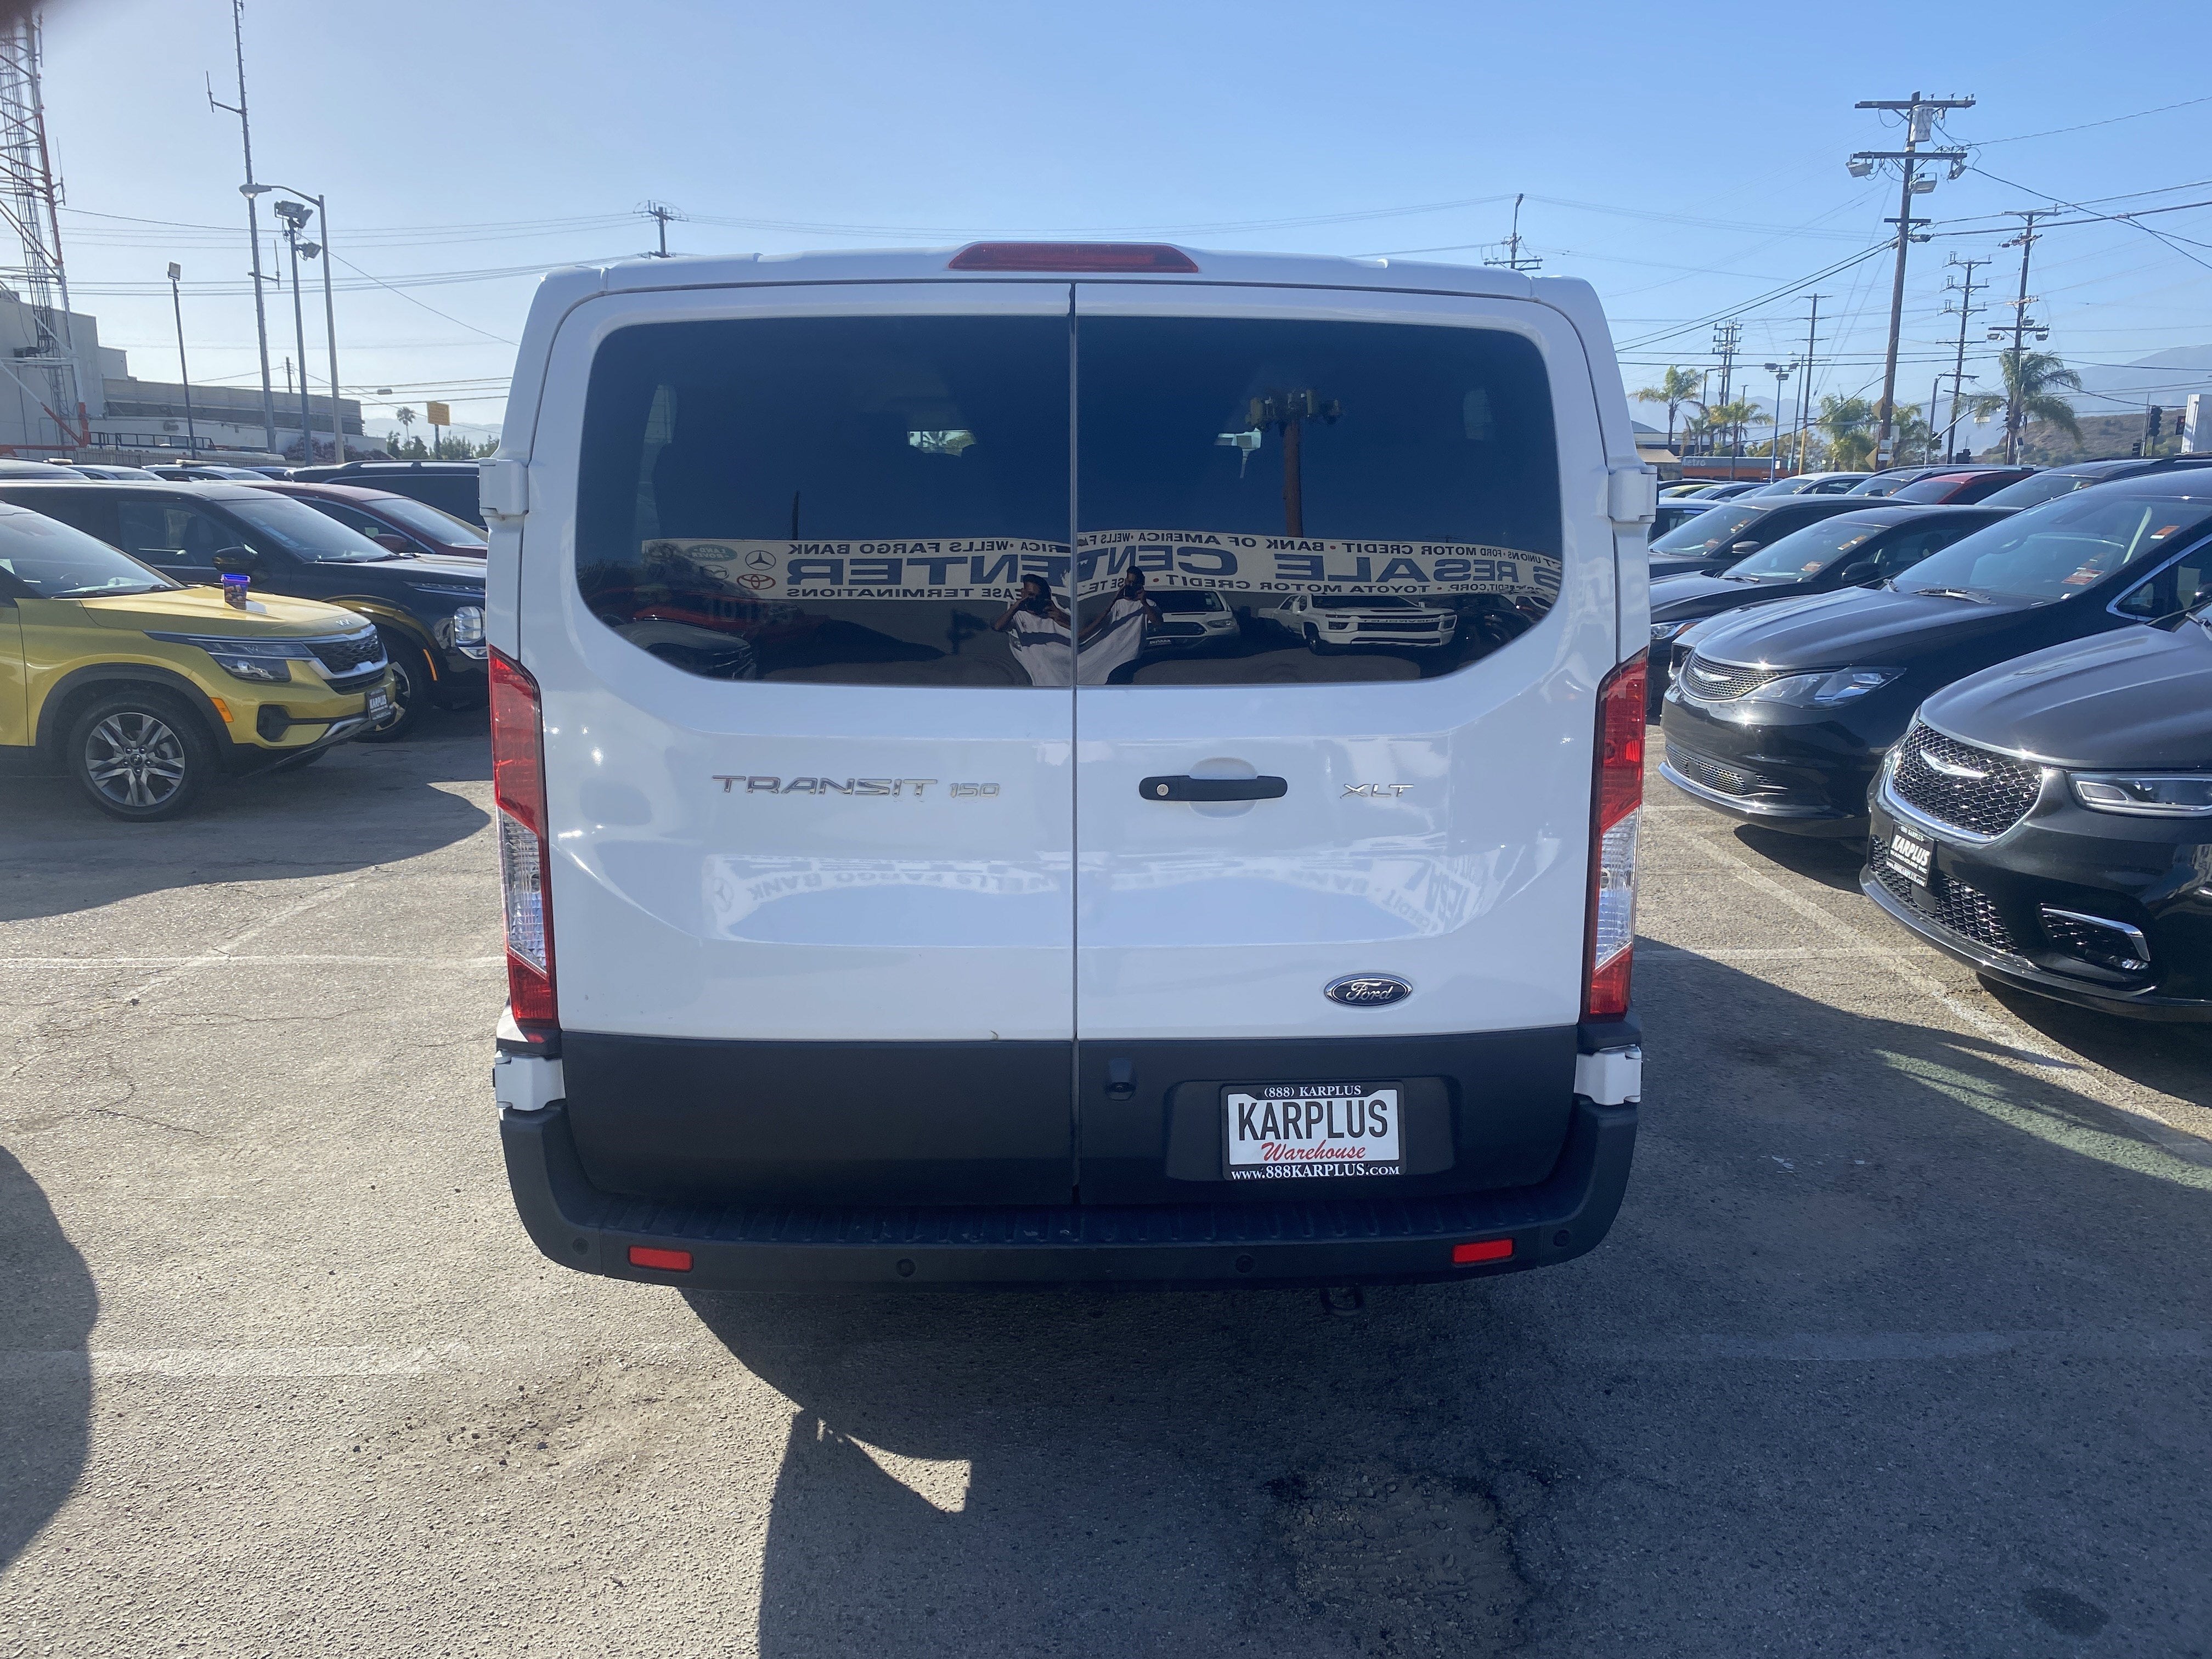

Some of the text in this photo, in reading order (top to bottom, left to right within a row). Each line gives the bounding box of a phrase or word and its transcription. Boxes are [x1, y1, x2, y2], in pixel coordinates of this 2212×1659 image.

[712, 775, 1001, 798] TRANSIT 150
[1340, 783, 1414, 799] XLT
[1891, 834, 1931, 866] KARPLUS
[1346, 982, 1394, 1001] Ford
[1264, 1085, 1362, 1098] (888) KARPLUS
[1238, 1099, 1388, 1141] KARPLUS
[1261, 1139, 1366, 1161] Warehouse
